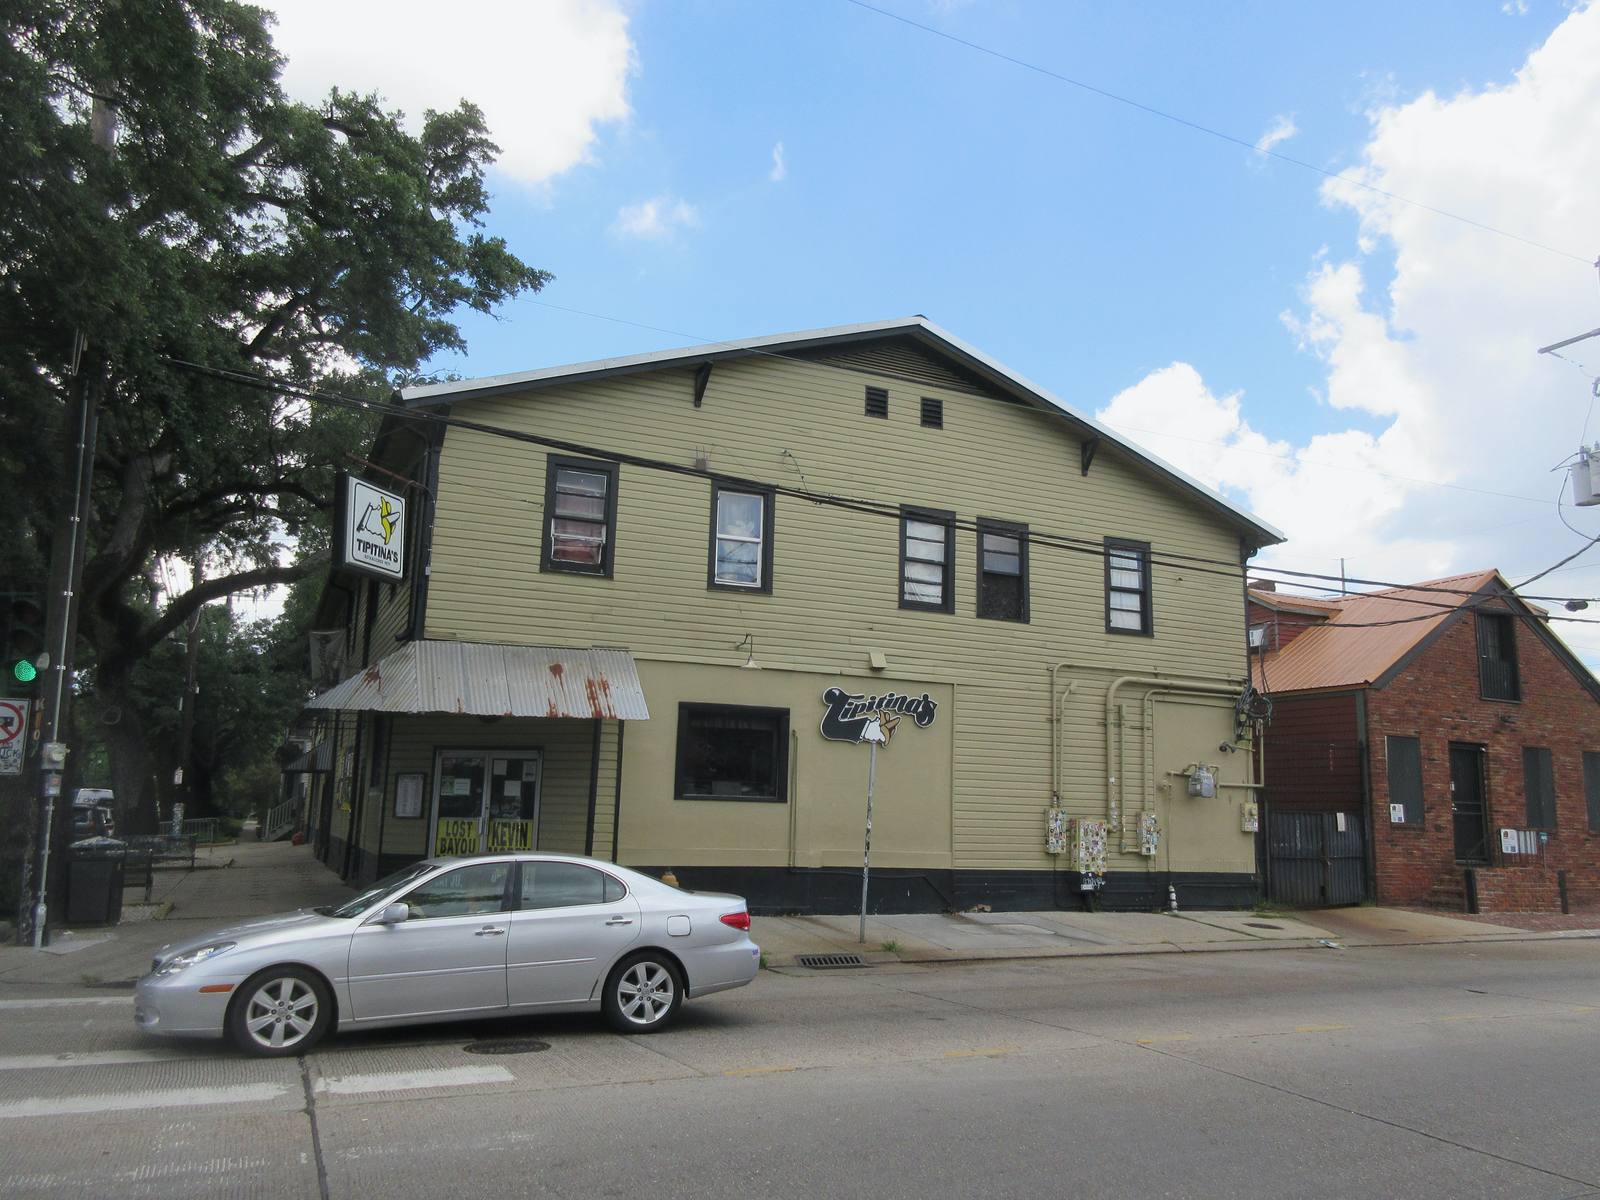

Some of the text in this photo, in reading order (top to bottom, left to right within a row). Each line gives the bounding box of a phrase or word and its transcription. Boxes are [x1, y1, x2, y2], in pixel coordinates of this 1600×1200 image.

[356, 538, 399, 563] TIPITINA'S
[446, 821, 473, 837] LOST
[492, 822, 528, 847] KEVIN
[440, 839, 476, 855] BAYOU
